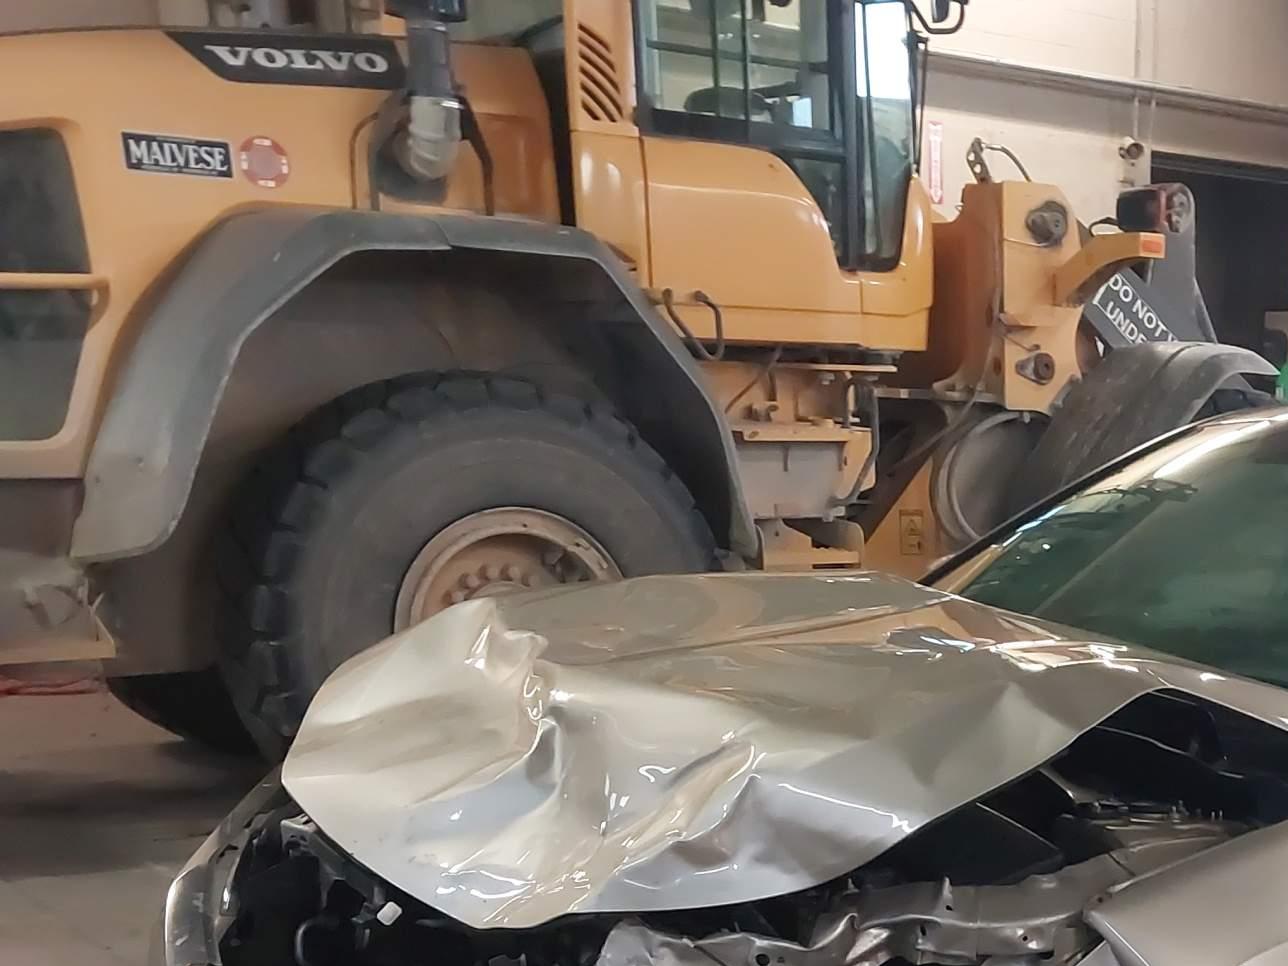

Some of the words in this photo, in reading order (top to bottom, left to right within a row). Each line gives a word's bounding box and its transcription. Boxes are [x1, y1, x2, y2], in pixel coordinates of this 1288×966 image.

[204, 45, 389, 73] VOLVO
[127, 138, 228, 171] MALVESE
[1108, 273, 1133, 302] DO
[1132, 299, 1168, 337] NOT
